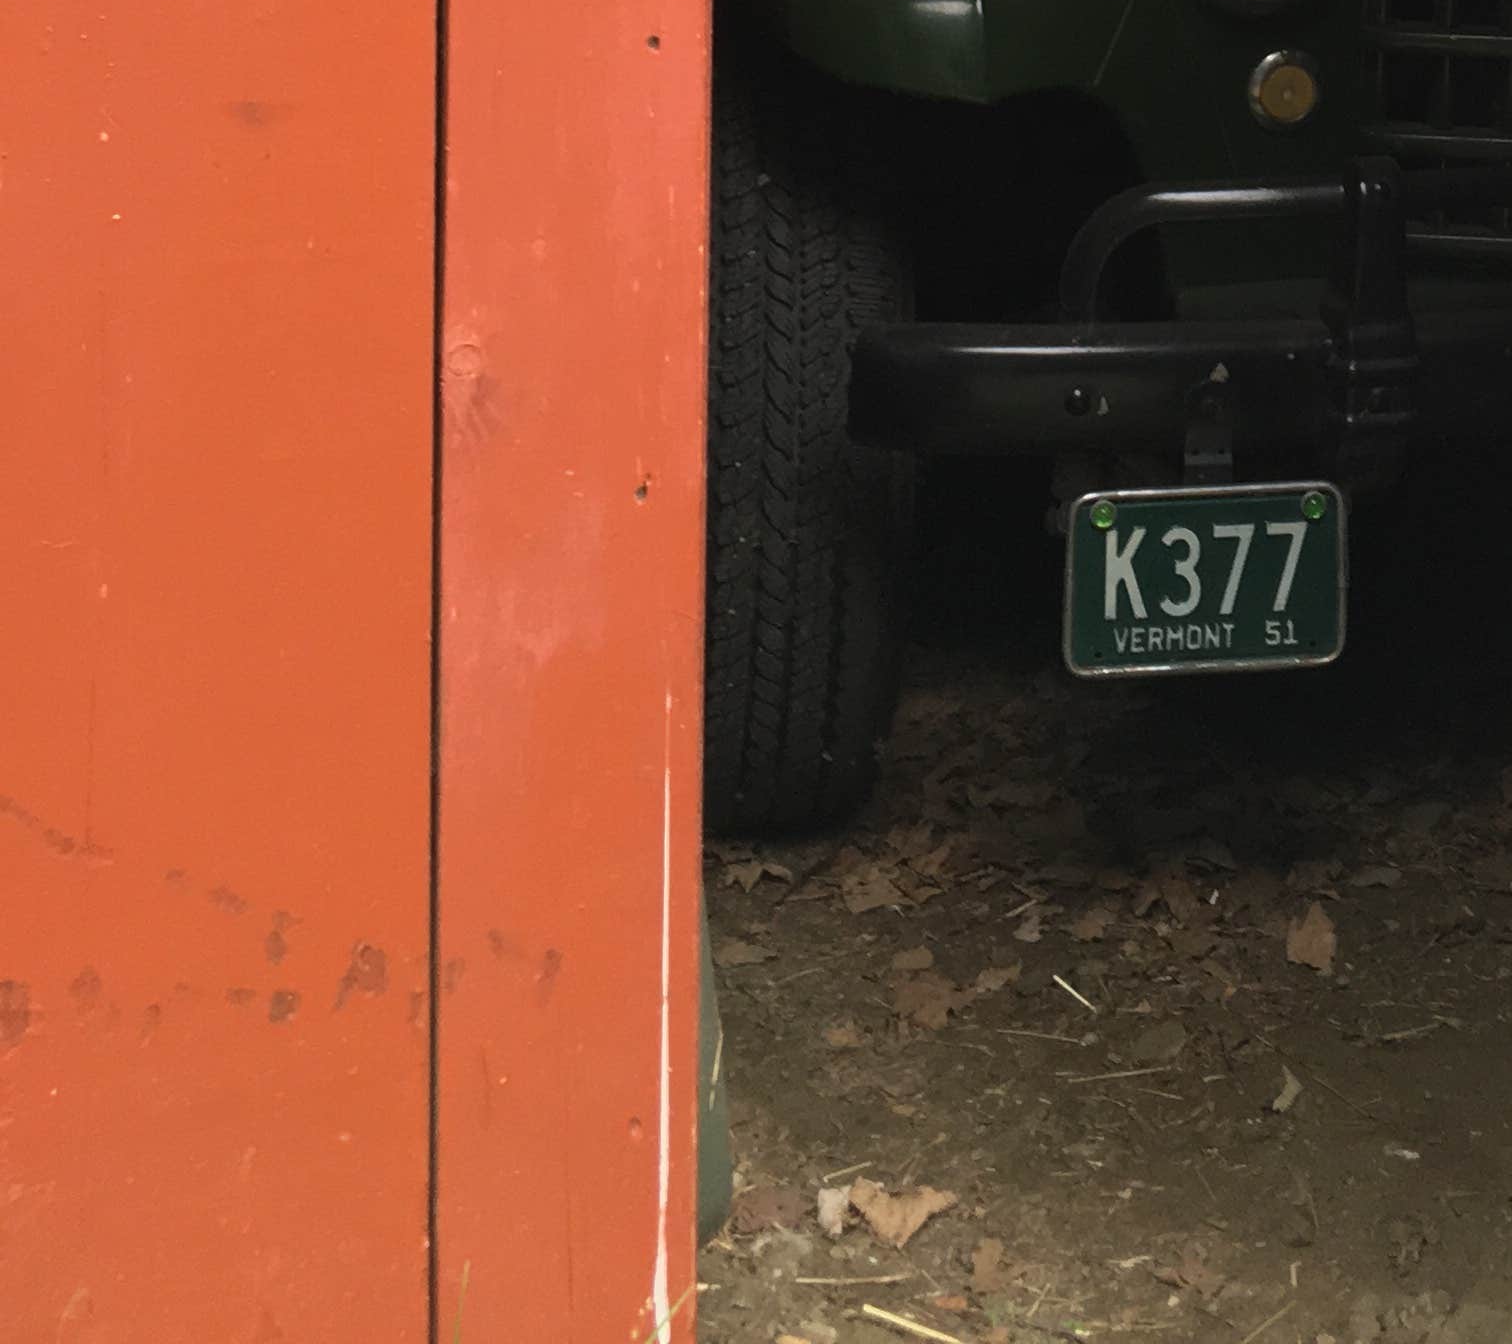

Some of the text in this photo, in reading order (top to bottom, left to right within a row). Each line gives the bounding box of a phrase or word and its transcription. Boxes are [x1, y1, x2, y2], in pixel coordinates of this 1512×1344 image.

[1103, 520, 1309, 621] K377
[1113, 619, 1299, 654] VERMONT 51
